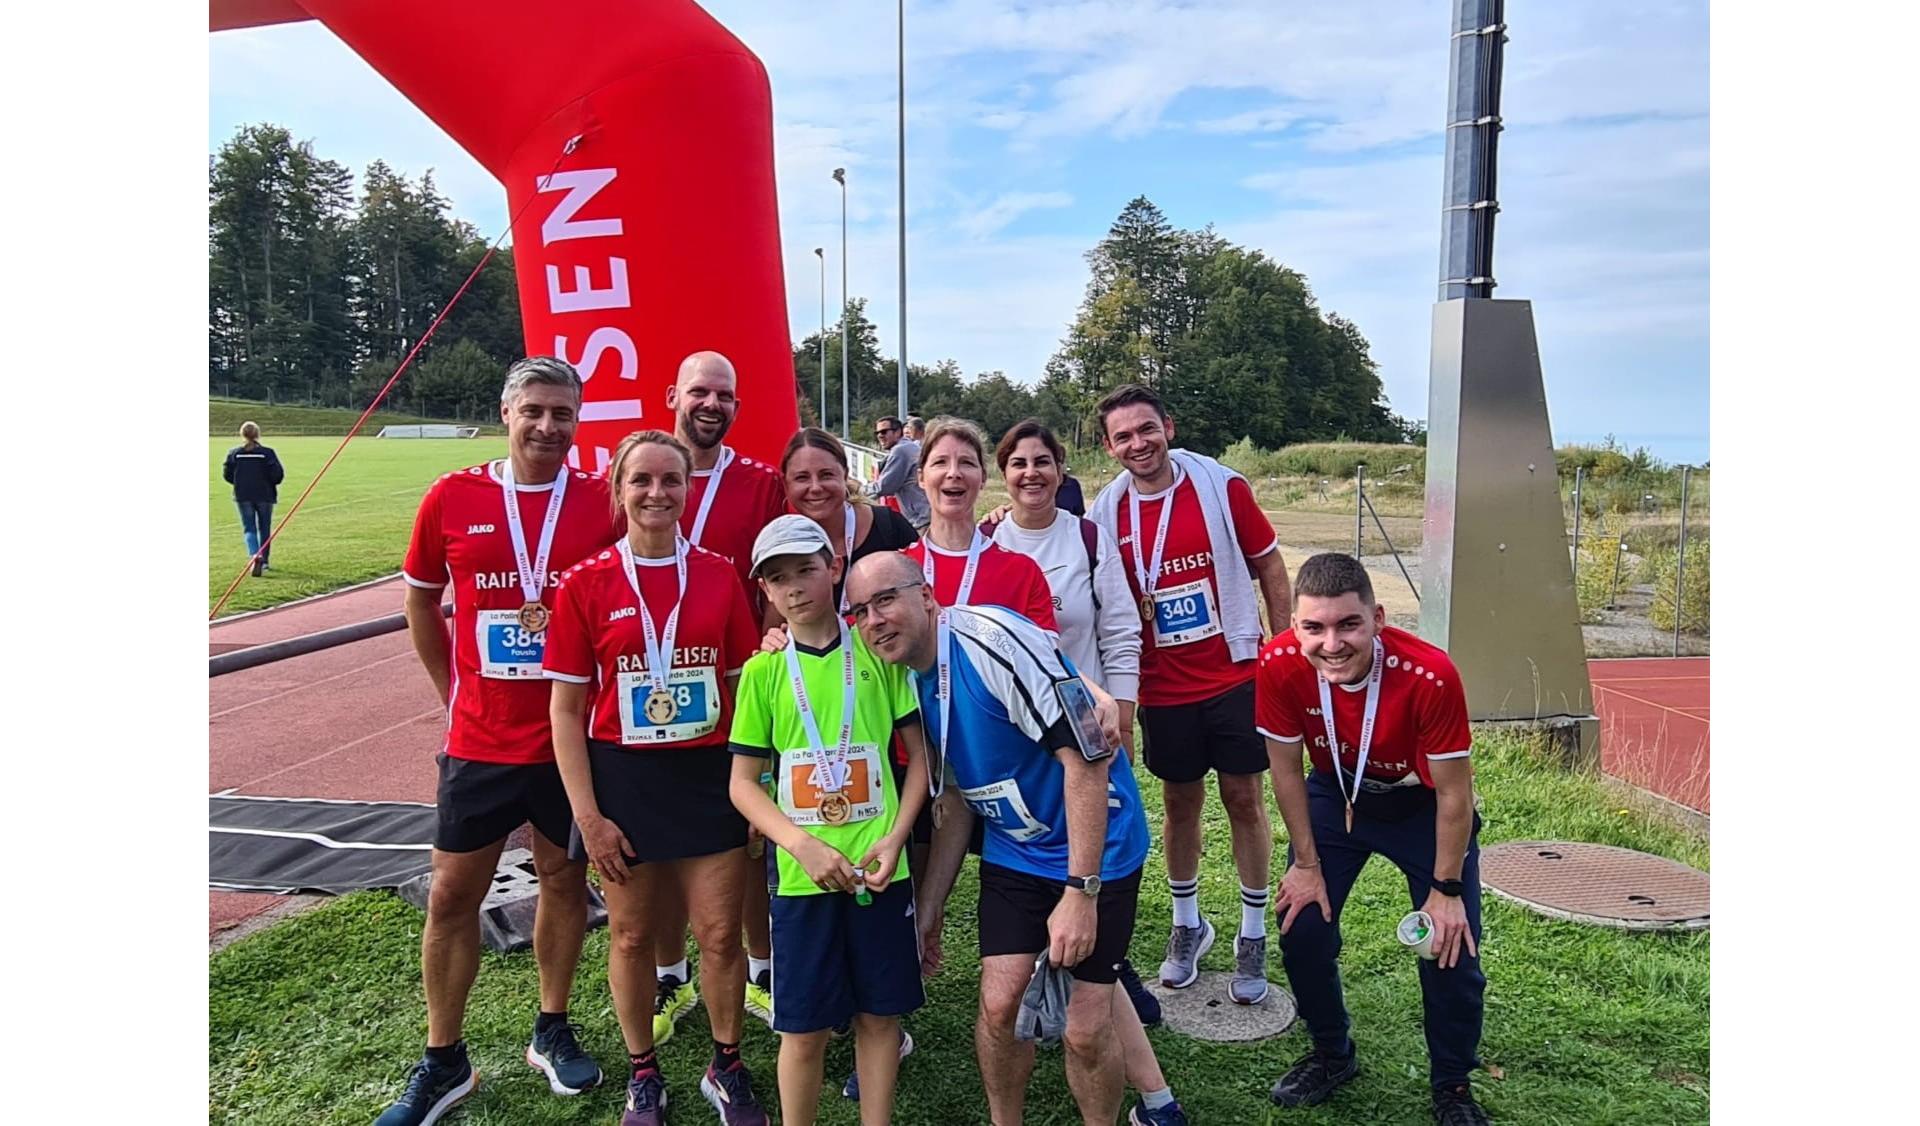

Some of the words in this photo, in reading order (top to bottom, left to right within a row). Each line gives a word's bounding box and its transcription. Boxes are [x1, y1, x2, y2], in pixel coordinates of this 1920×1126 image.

[467, 524, 495, 534] JAKO
[609, 606, 636, 621] JAKO
[1162, 597, 1196, 619] 340
[501, 627, 546, 648] 384
[617, 646, 718, 671] RAIEISEN
[686, 669, 704, 678] 2024
[648, 685, 691, 707] 78
[847, 745, 866, 754] 2024
[807, 763, 854, 788] 42
